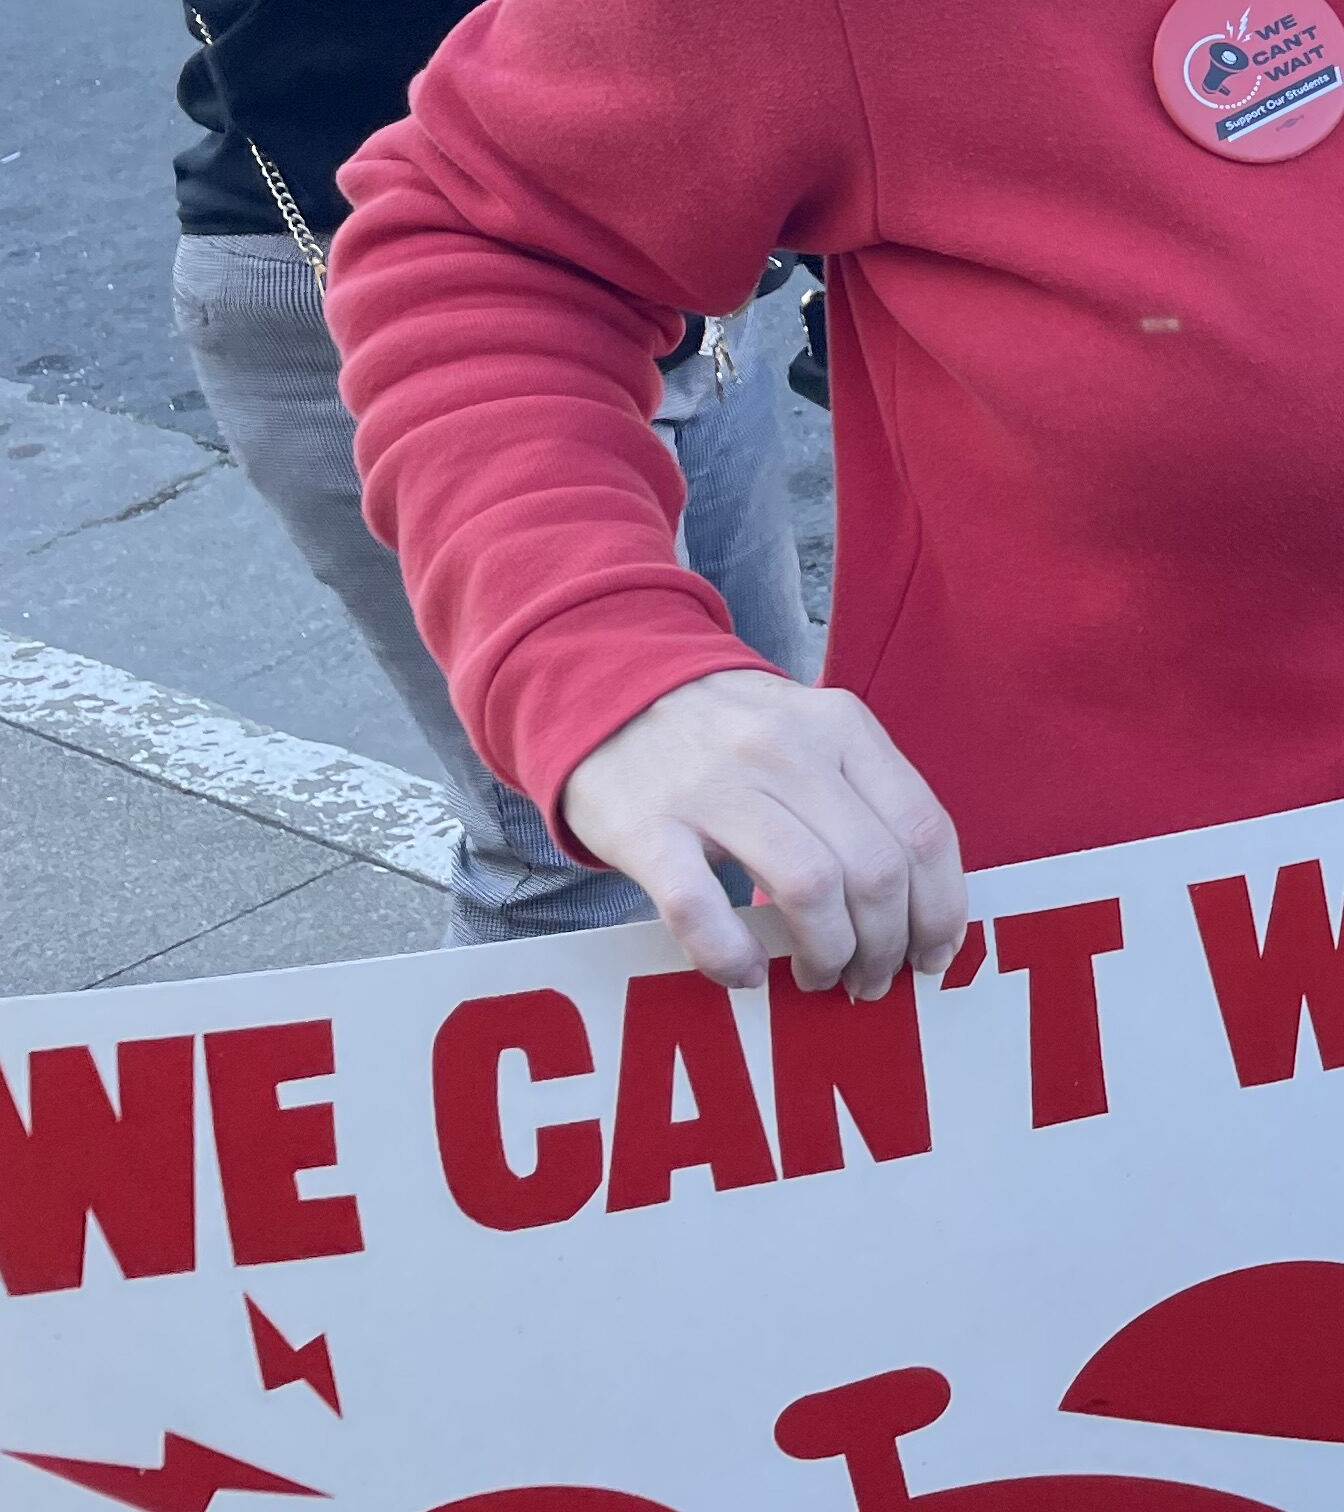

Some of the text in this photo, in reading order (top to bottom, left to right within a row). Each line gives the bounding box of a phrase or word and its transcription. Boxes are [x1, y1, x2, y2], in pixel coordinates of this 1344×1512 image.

[1252, 25, 1317, 66] CAN'T
[1254, 14, 1298, 41] WE
[1264, 44, 1324, 82] WAIT
[1225, 73, 1330, 131] Support Our Students
[0, 1018, 365, 1297] WE
[432, 896, 1124, 1232] CAN'T
